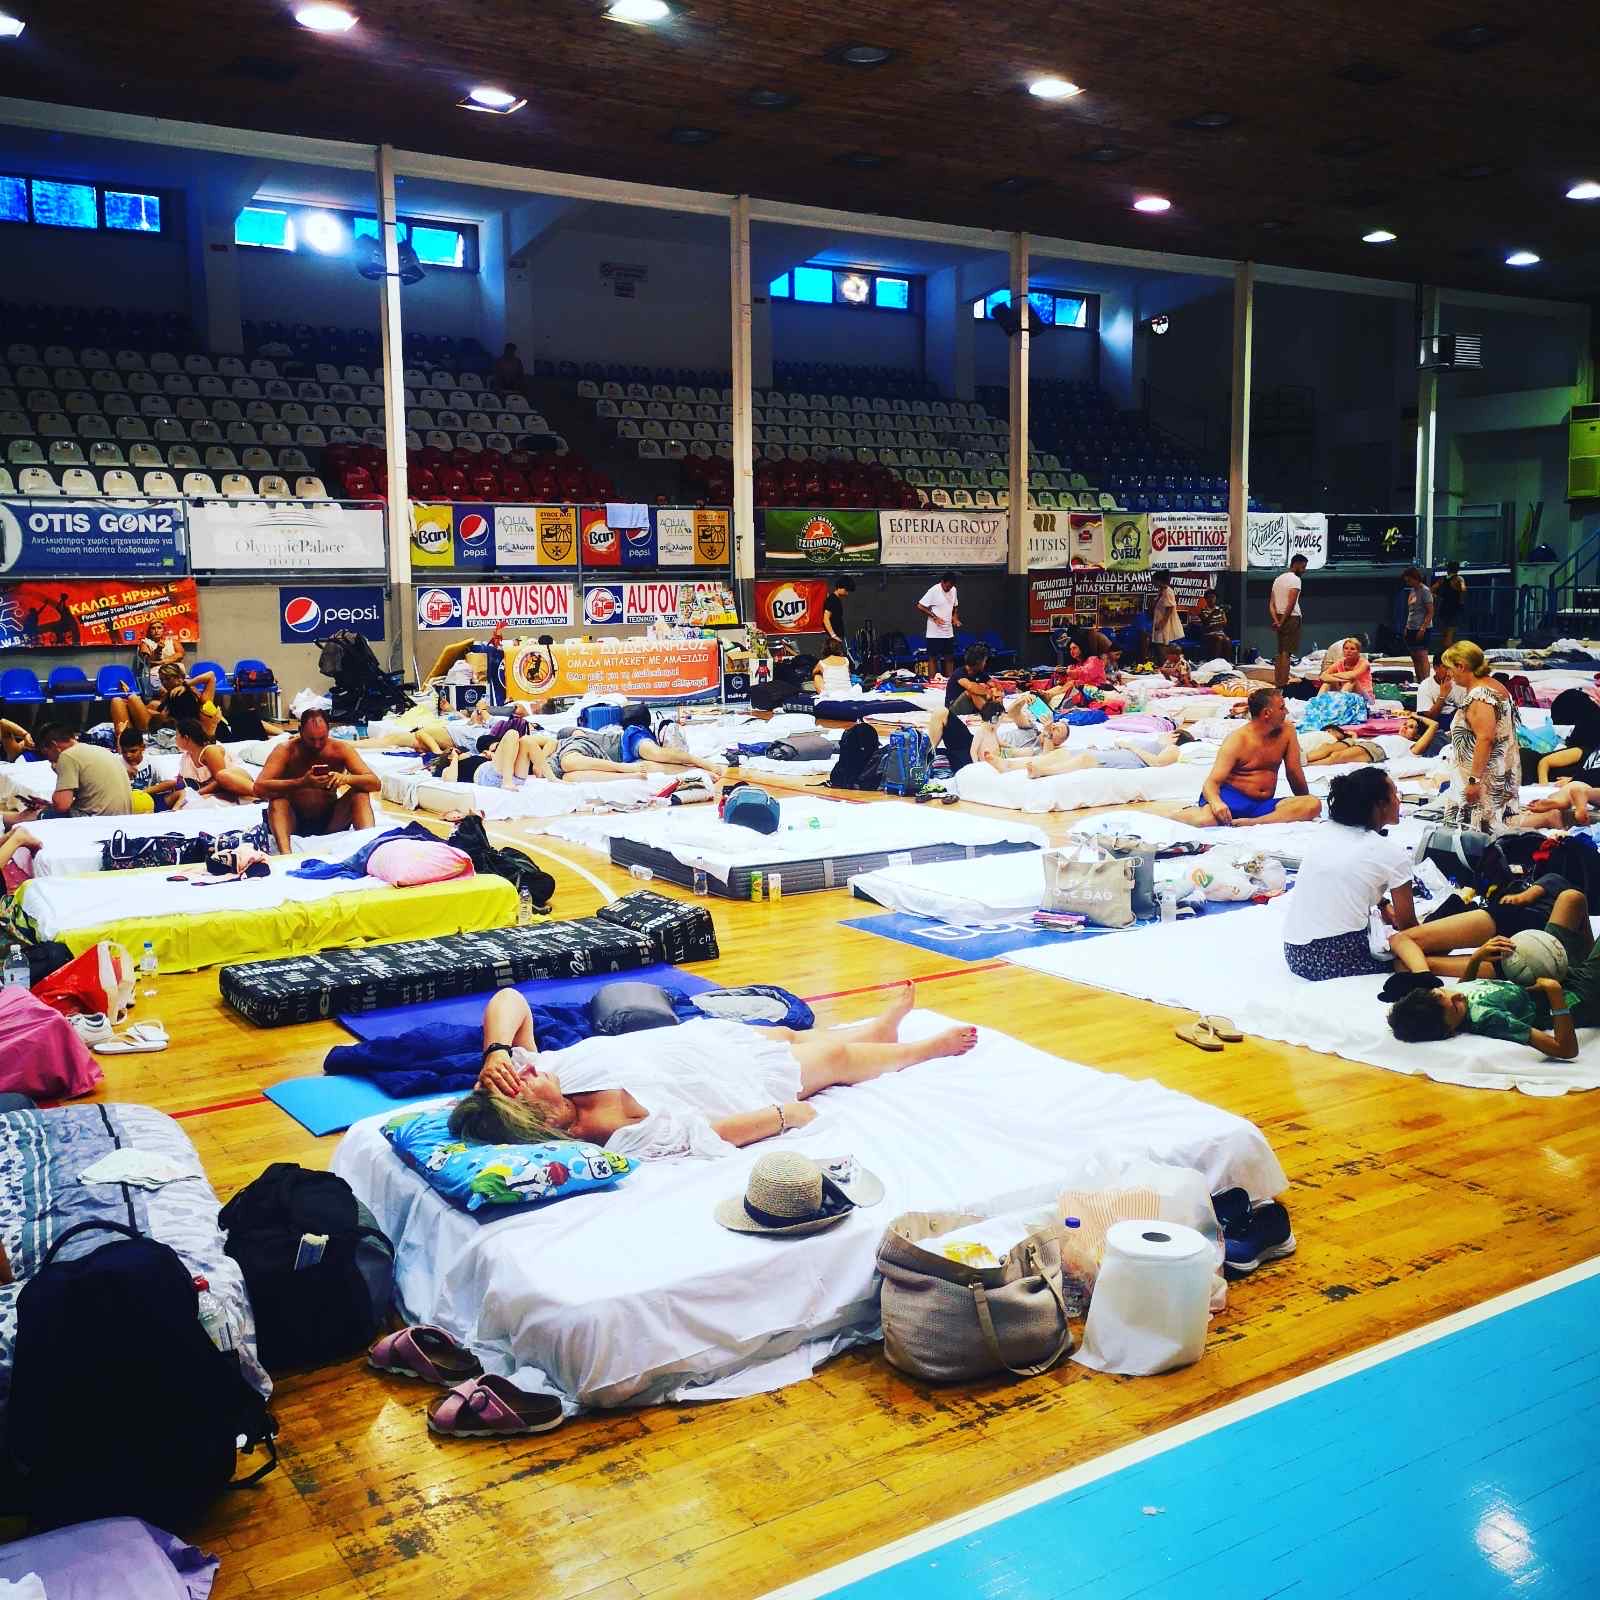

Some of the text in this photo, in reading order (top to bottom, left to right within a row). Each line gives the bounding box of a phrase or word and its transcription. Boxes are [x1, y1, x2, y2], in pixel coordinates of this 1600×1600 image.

[29, 513, 91, 533] OTIS
[889, 518, 1000, 534] ESPERIA GROUP
[1167, 530, 1228, 546] ΚΡΗΤΙΚΟΣ
[466, 585, 568, 616] AUTOVISION
[468, 619, 498, 627] ΤΕΧΝΙΚΟ
